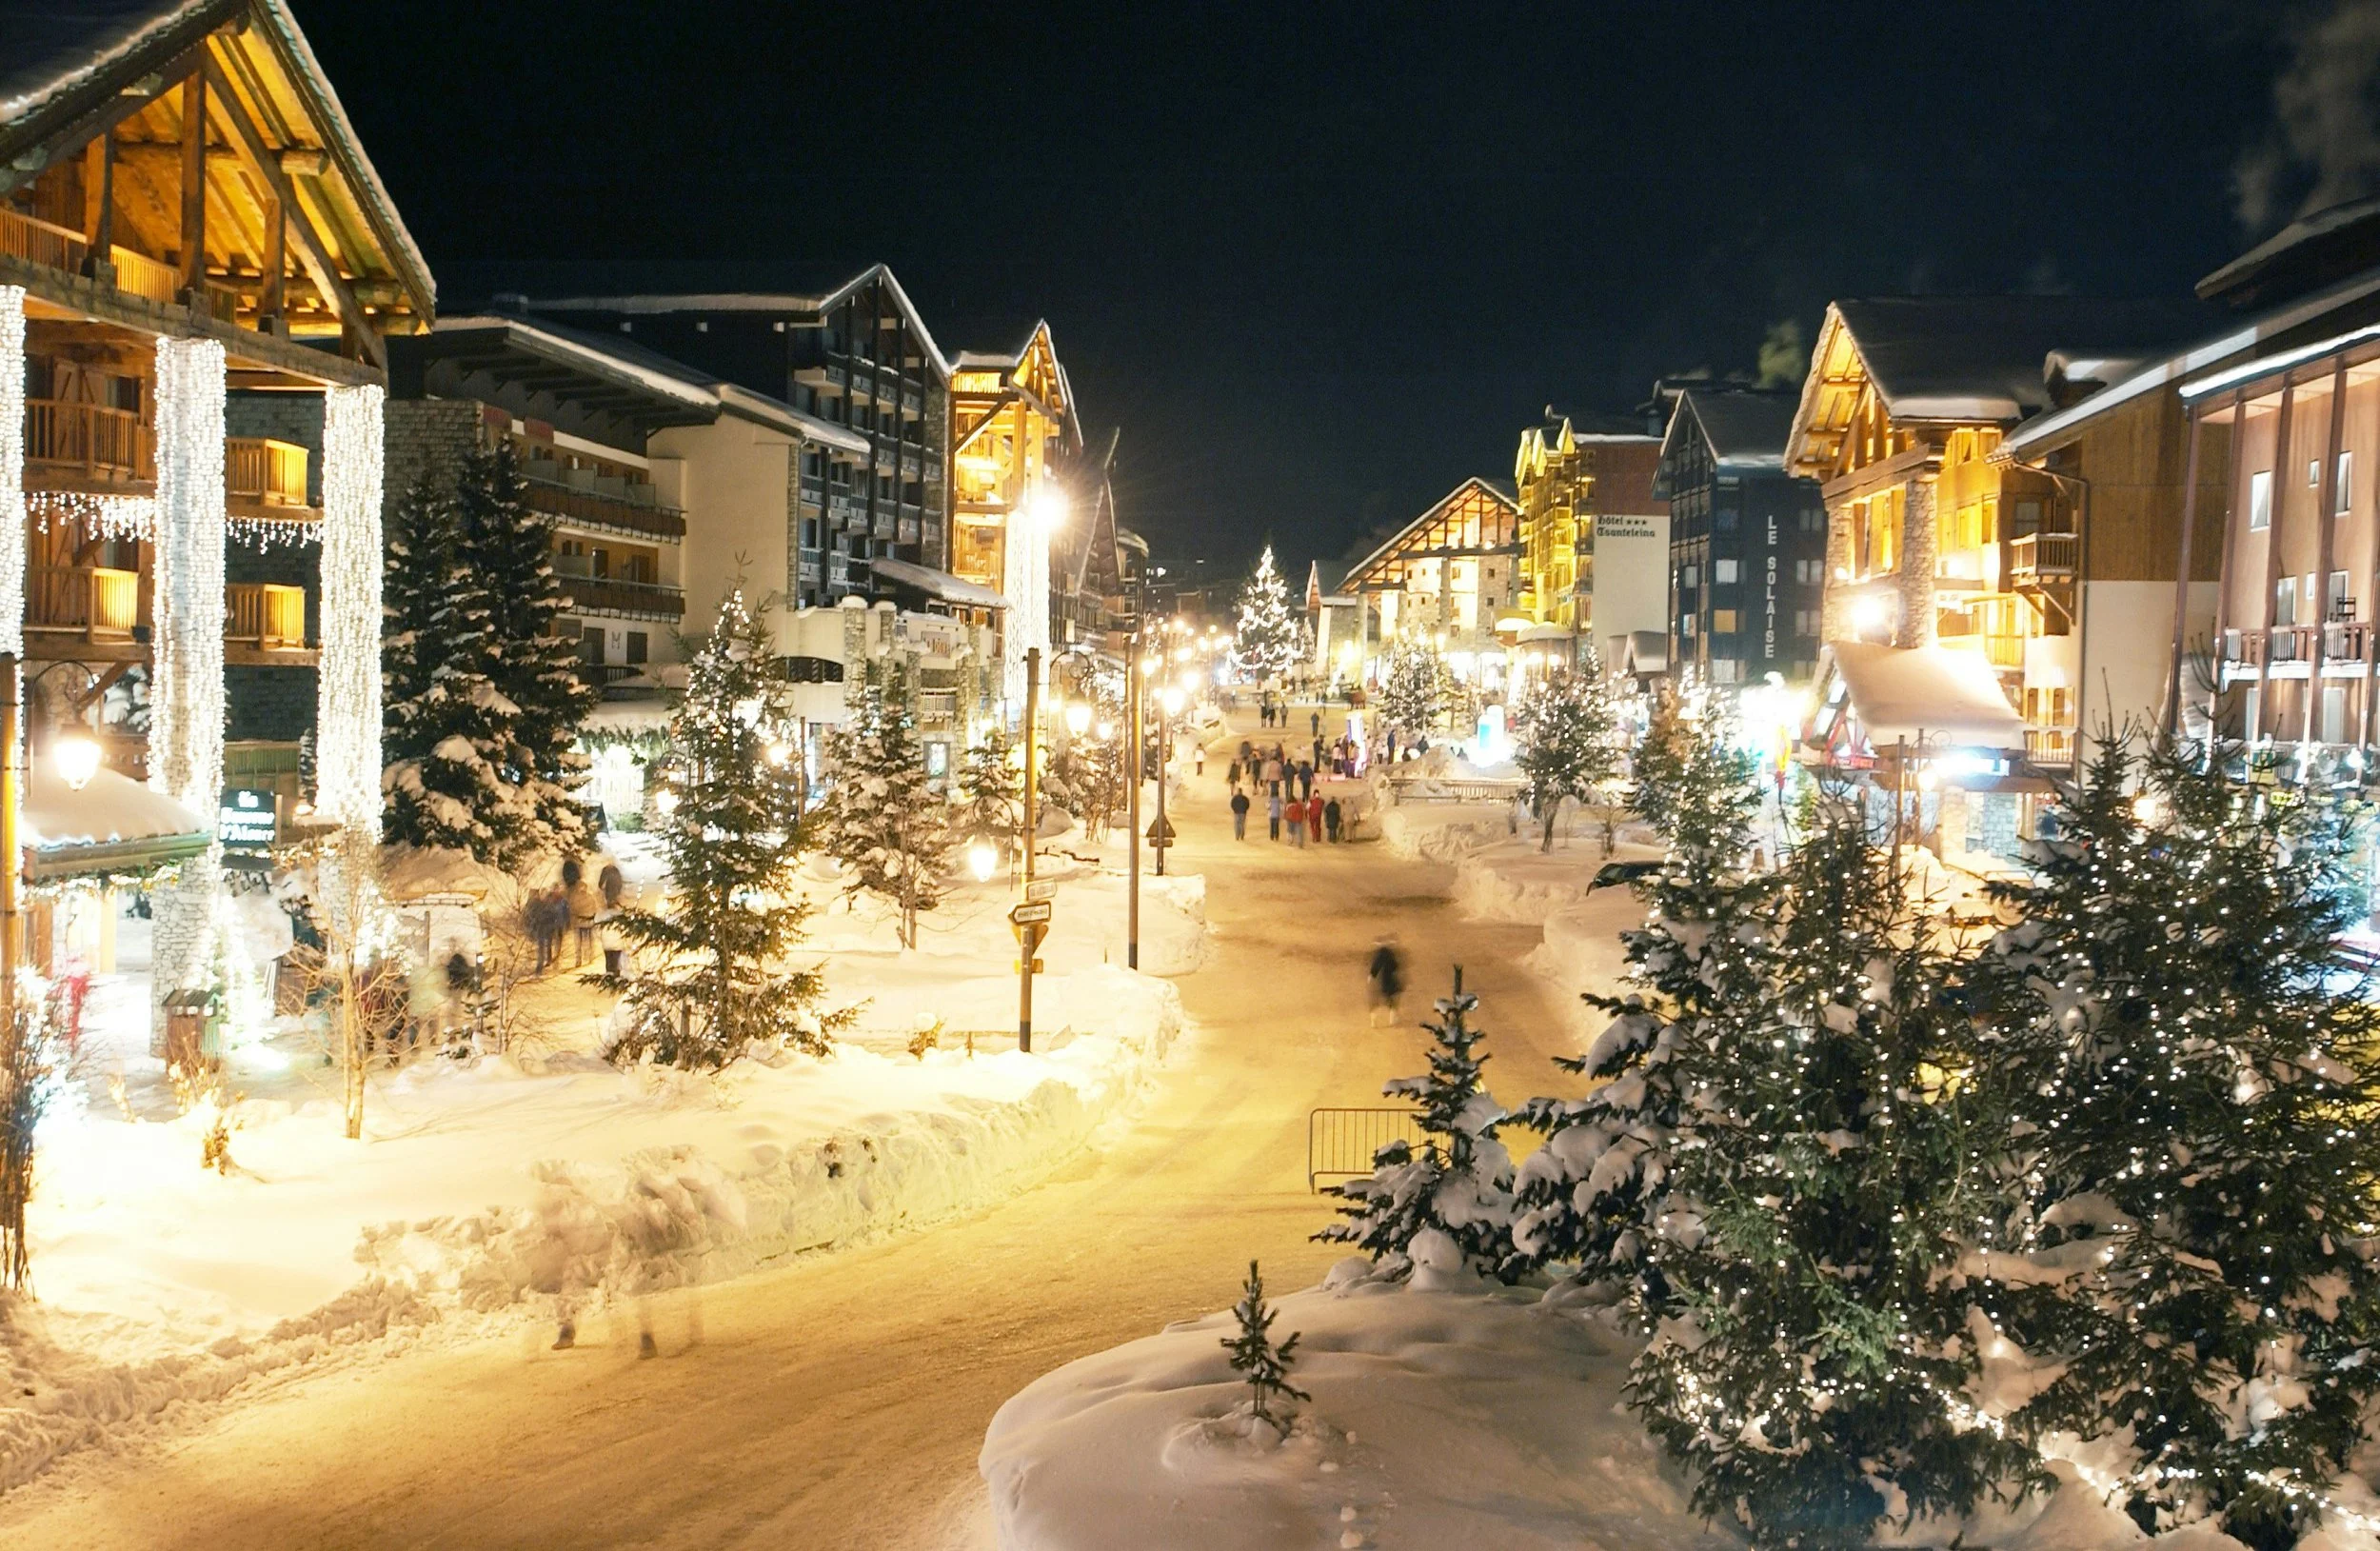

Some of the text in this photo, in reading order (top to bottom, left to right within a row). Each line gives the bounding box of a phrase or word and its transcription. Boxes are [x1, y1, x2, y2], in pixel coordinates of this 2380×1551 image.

[1597, 515, 1623, 525] Hôtel
[1765, 515, 1777, 658] LE SOLAISE
